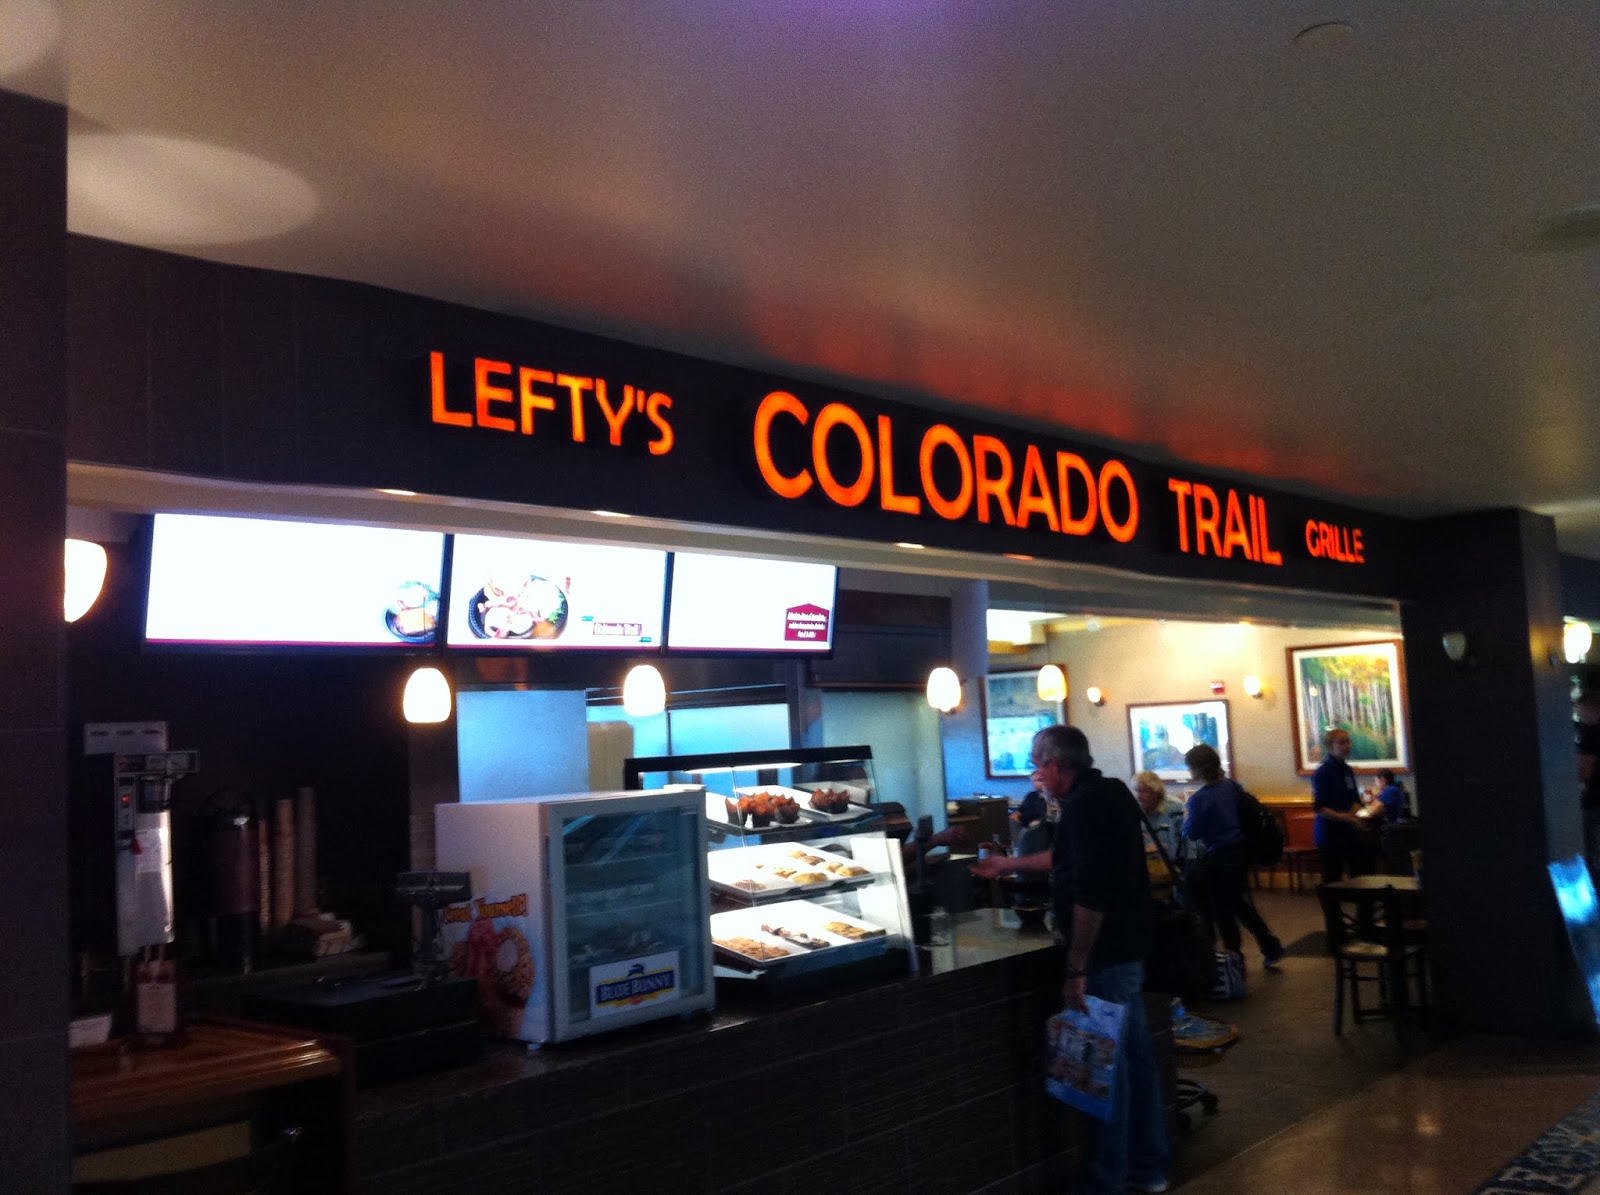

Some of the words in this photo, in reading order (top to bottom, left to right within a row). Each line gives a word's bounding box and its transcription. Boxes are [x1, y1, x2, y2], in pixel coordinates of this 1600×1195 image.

[429, 350, 675, 457] LEFTY'S
[753, 390, 1139, 543] COLORADO
[1168, 477, 1283, 566] TRAIL
[1305, 519, 1364, 564] GRILLE
[601, 981, 631, 1002] BLUE
[632, 973, 672, 995] BUNNY
